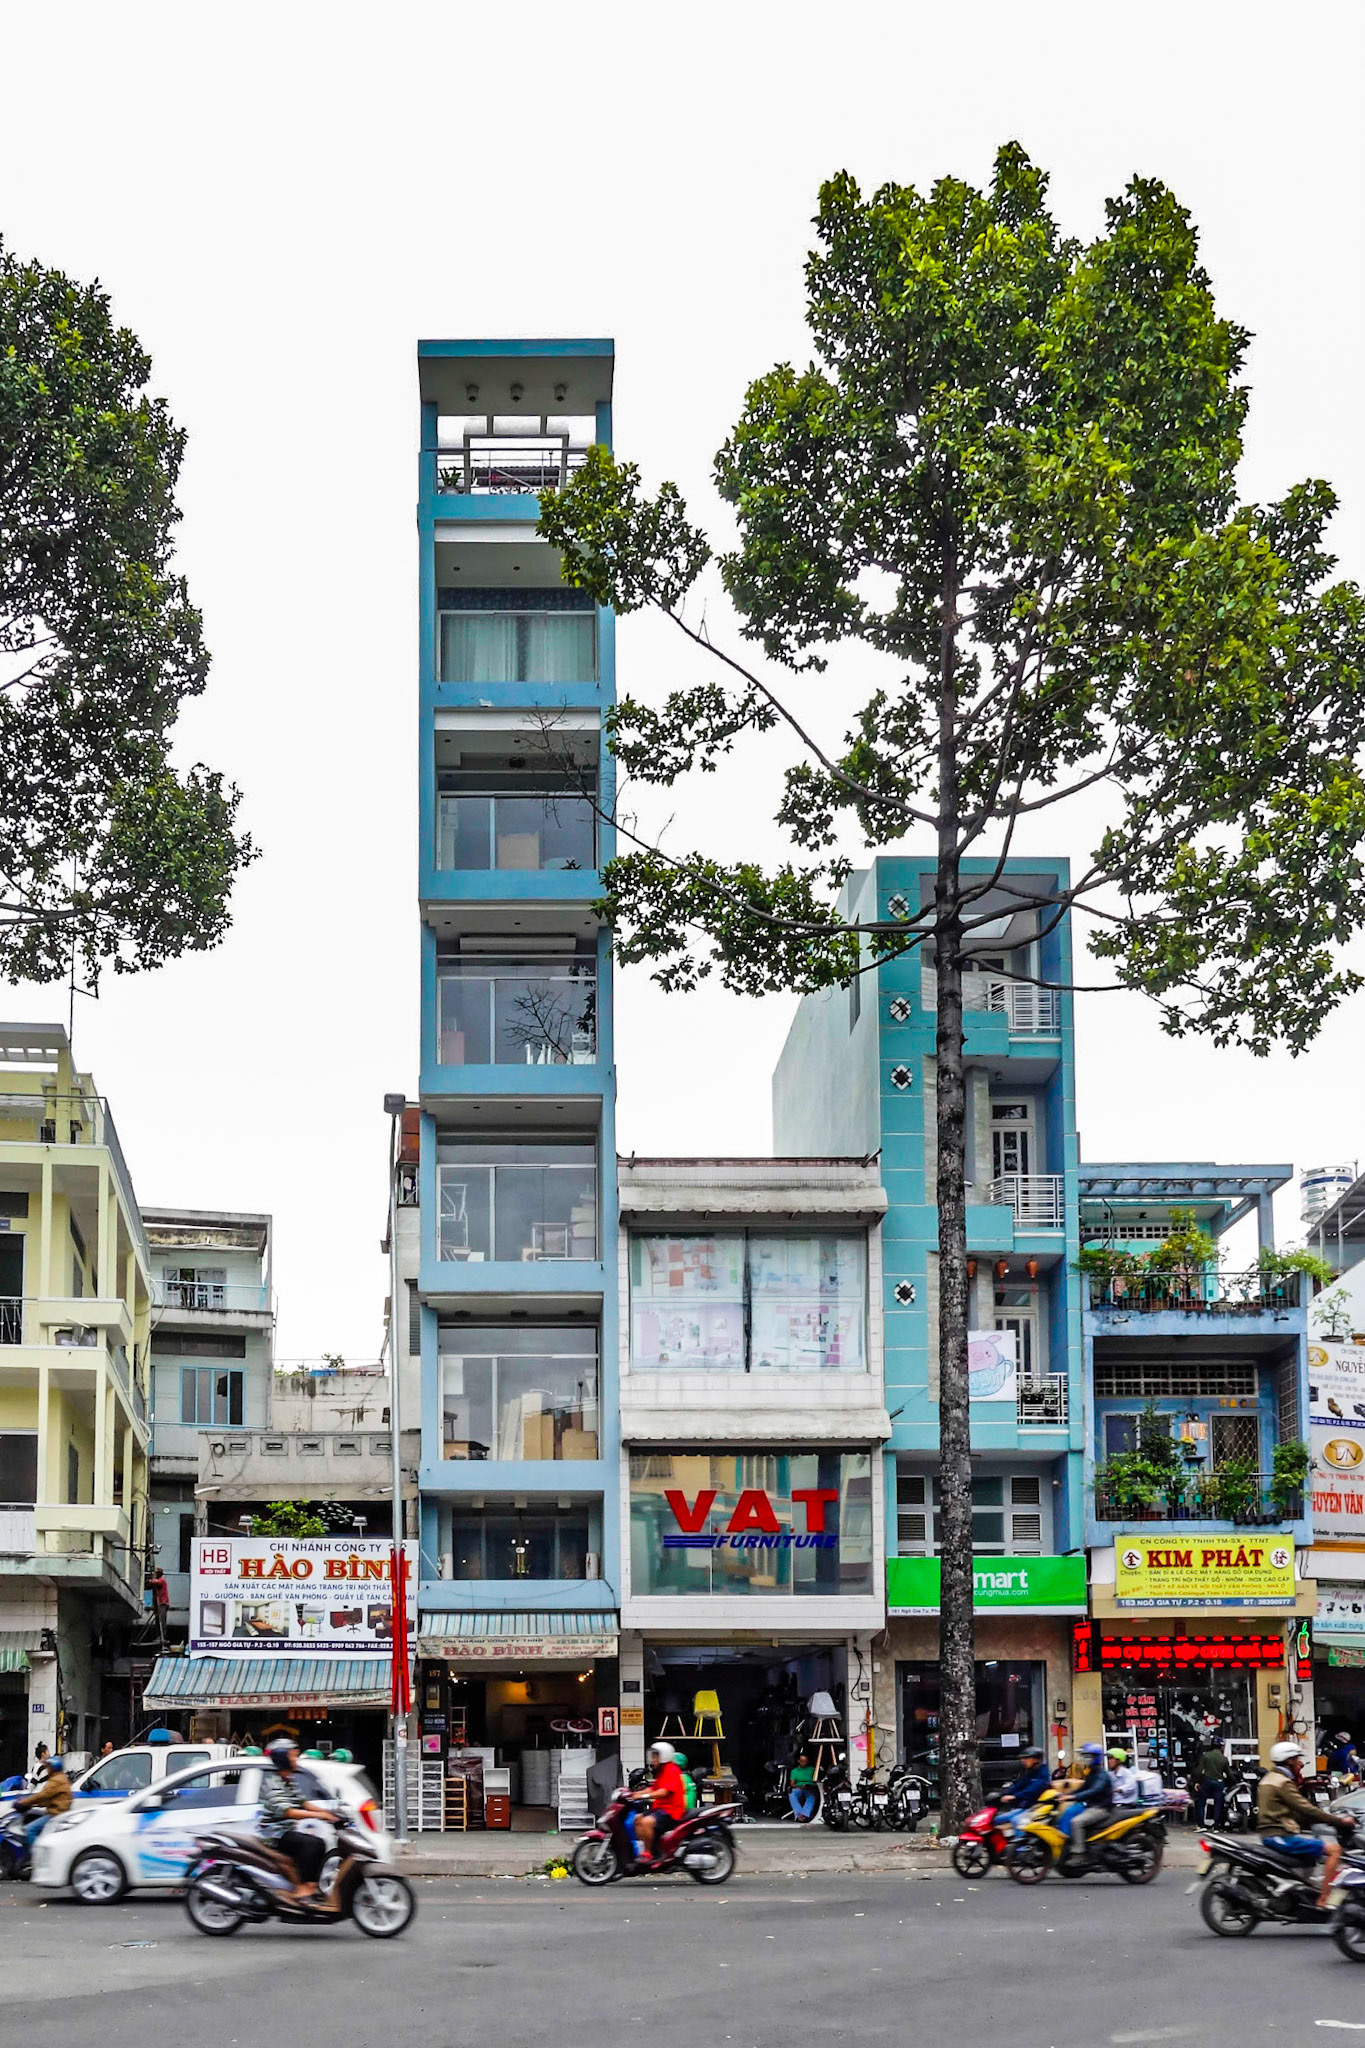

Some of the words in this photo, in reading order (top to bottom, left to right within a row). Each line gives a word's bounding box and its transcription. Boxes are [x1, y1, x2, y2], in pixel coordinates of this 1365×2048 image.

[1335, 1356, 1365, 1374] NGUYỄ
[269, 1543, 289, 1552] CHI
[292, 1541, 331, 1552] NHÁNH
[334, 1541, 367, 1552] CÔNG
[369, 1544, 382, 1552] TY
[716, 1535, 840, 1549] FURNITURE
[1153, 1537, 1178, 1545] CÔNG
[202, 1549, 228, 1563] HB
[1146, 1550, 1193, 1568] KIM
[1201, 1544, 1264, 1567] PHÁT
[237, 1553, 314, 1580] HÀO
[973, 1568, 1028, 1589] mart
[224, 1582, 240, 1590] SẢN
[261, 1582, 276, 1590] CÁC
[973, 1589, 1029, 1597] cungmua.com
[1136, 1598, 1155, 1606] NGÔ
[443, 1644, 488, 1656] HÀO
[492, 1643, 544, 1656] BÌNH
[269, 1692, 319, 1703] BÌNH
[957, 1731, 970, 1741] 51
